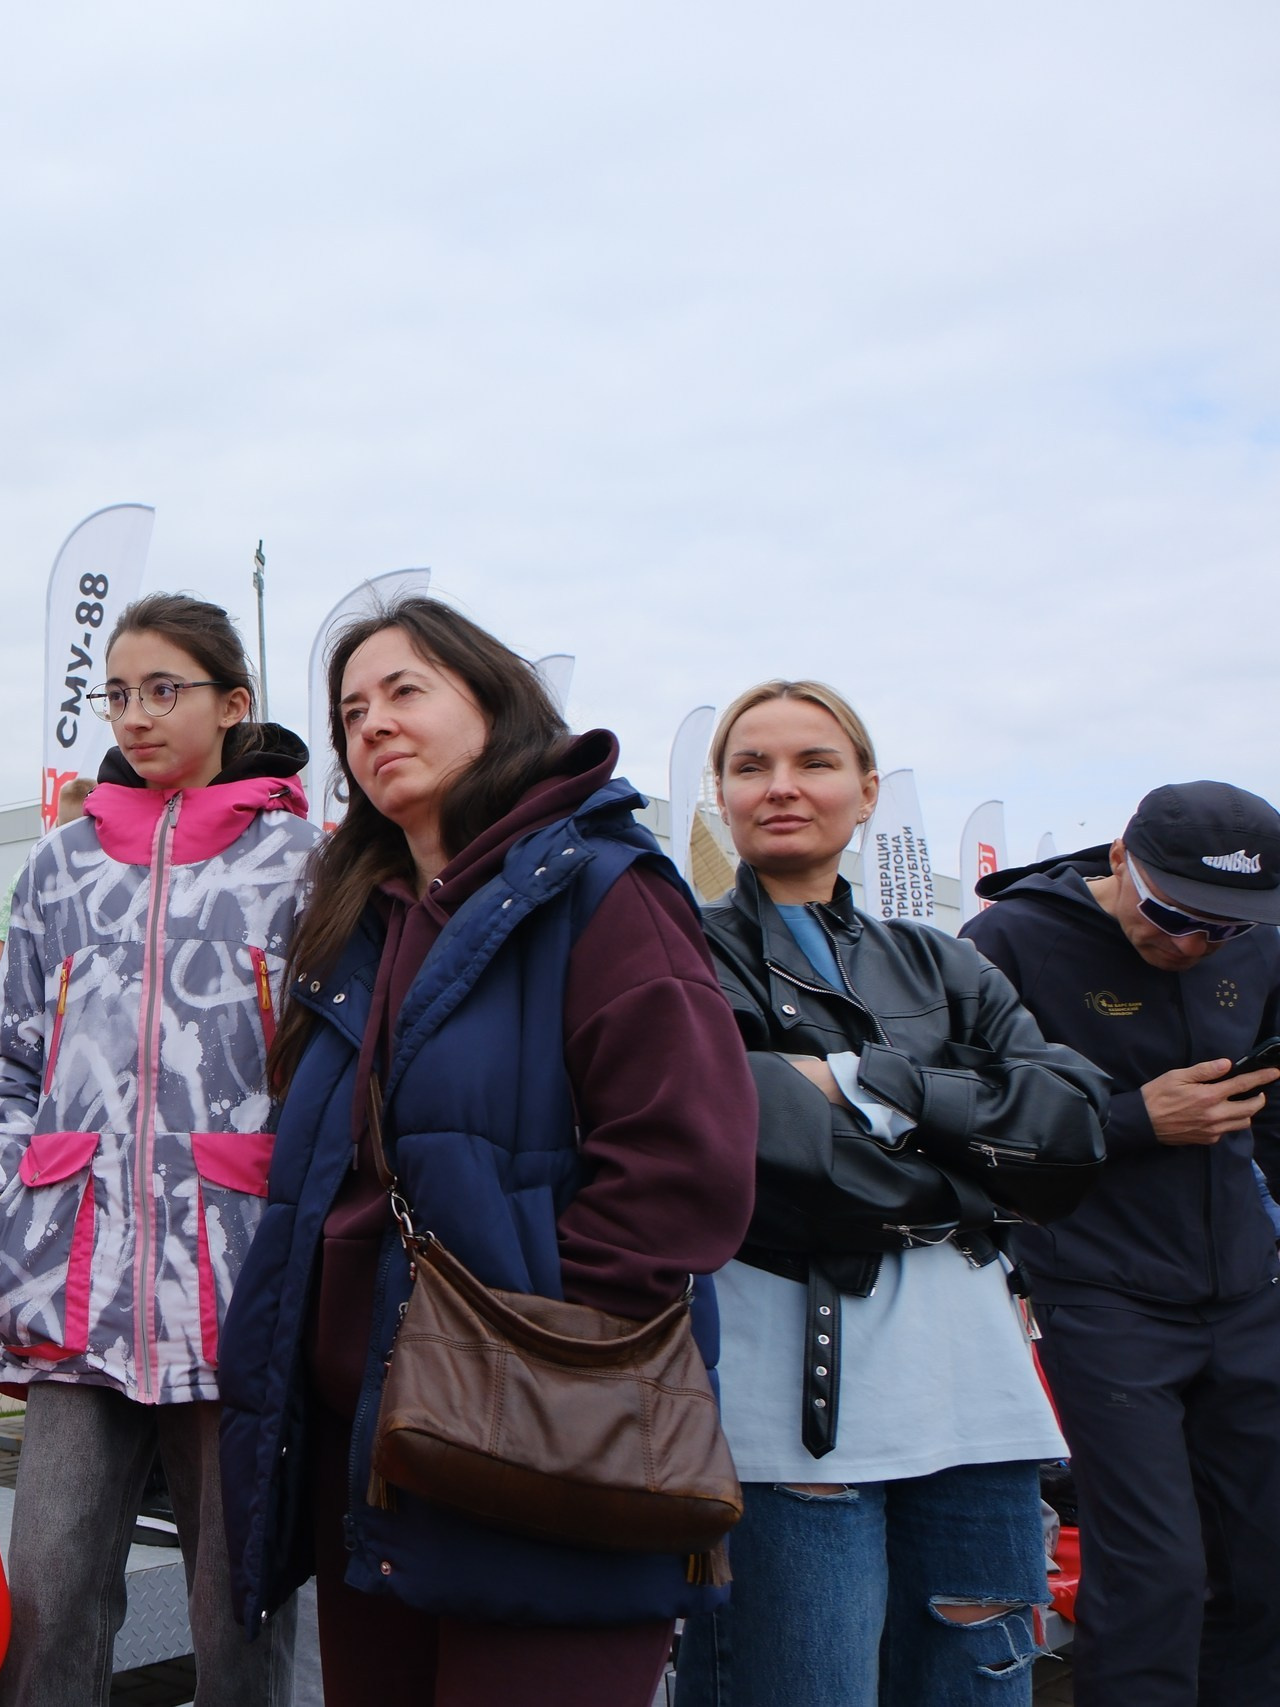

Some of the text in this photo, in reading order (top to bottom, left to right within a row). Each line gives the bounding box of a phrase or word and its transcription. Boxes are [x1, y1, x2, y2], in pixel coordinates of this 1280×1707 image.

[56, 572, 109, 748] СМУ-88
[876, 833, 895, 918] ФЕДЕРАЦИЯ
[891, 835, 909, 918] ТРИАТЛОНА
[902, 826, 923, 917] РЕСПУБЛИКИ
[916, 838, 934, 917] ТАТАРСТАН
